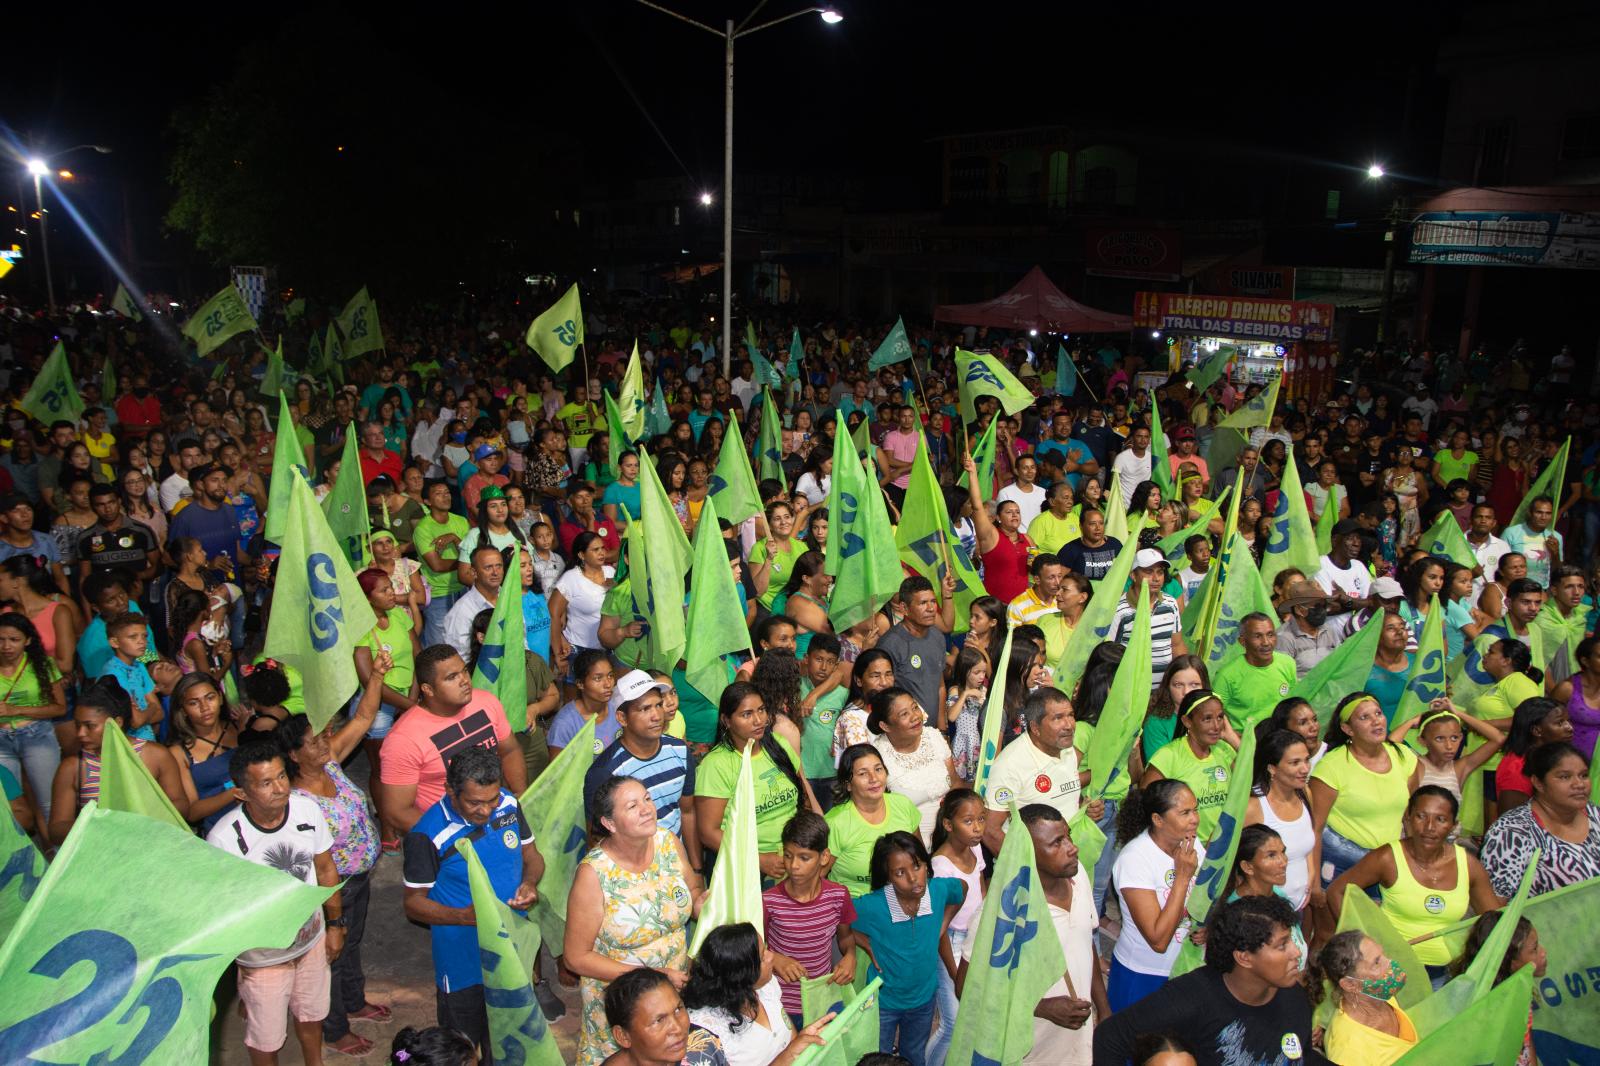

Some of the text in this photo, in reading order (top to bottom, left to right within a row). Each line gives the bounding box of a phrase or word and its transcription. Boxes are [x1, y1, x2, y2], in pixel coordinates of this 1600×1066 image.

[1231, 270, 1282, 288] SILVANA
[1231, 302, 1292, 323] DRINKS
[1202, 320, 1231, 333] DAS
[1233, 324, 1303, 339] BEBIDAS
[96, 550, 137, 561] RUGBY
[506, 832, 514, 841] 25
[675, 888, 683, 898] 25
[1430, 897, 1440, 905] 25
[1285, 1037, 1297, 1047] 25
